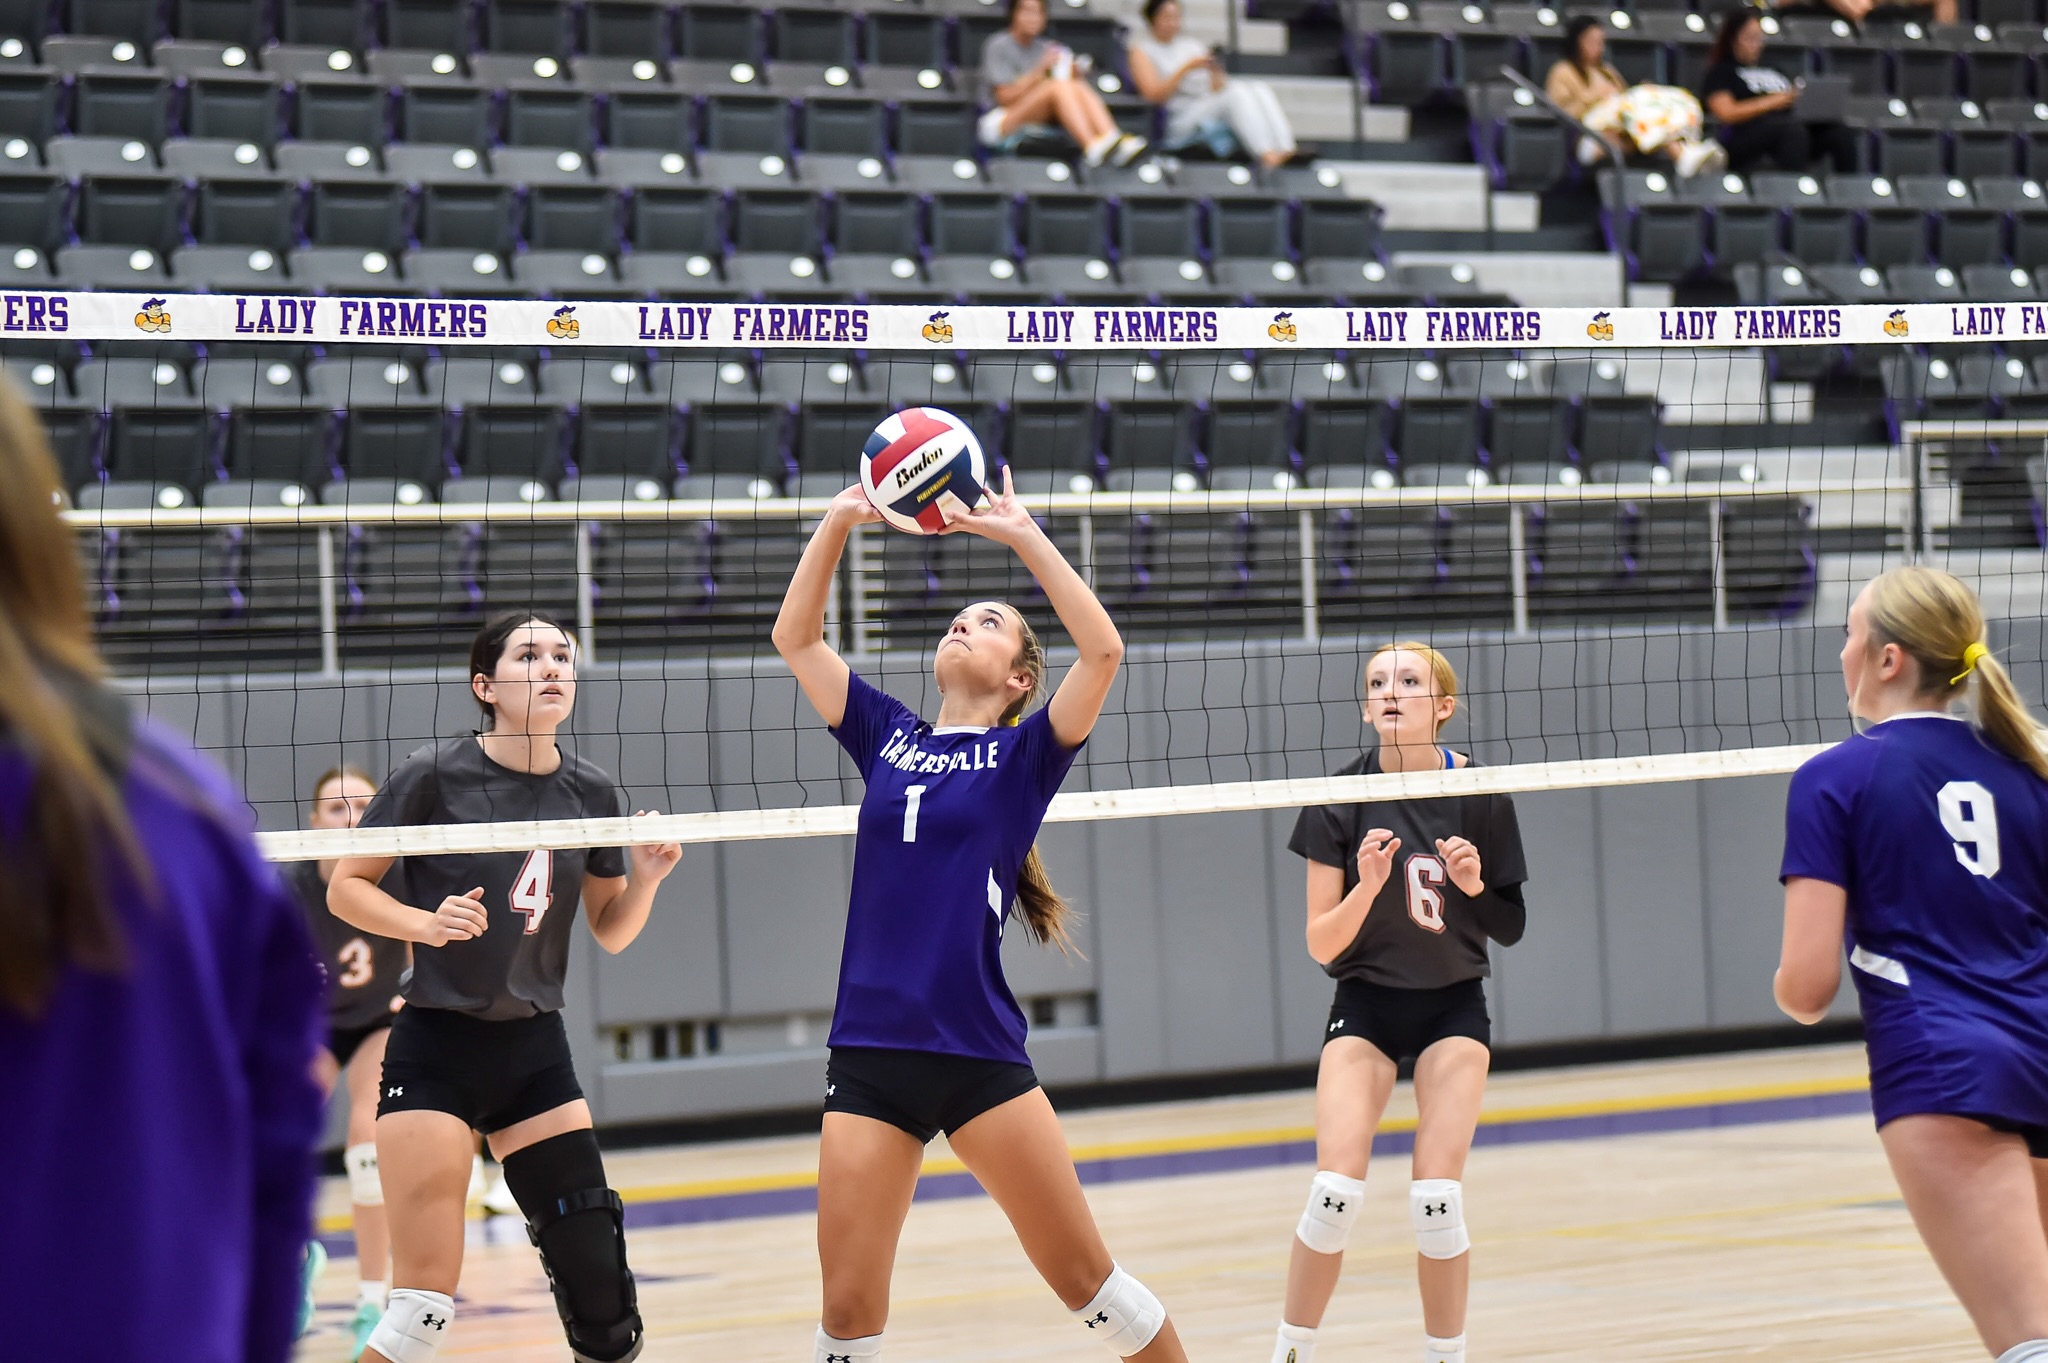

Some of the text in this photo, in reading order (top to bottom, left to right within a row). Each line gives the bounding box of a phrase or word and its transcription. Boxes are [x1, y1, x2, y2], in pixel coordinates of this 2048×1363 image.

[0, 296, 68, 331] ERS
[235, 299, 487, 338] LADY FARMERS
[638, 307, 869, 342] LADY FARMERS
[1007, 311, 1218, 342] LADY FARMERS
[1346, 311, 1541, 342] LADY FARMERS
[1660, 309, 1841, 340] LADY FARMERS
[1952, 306, 2048, 335] LADY FA
[903, 785, 927, 842] 1
[1936, 781, 2001, 879] 9
[508, 849, 554, 935] 4
[1404, 853, 1447, 935] 6
[338, 937, 375, 989] 3
